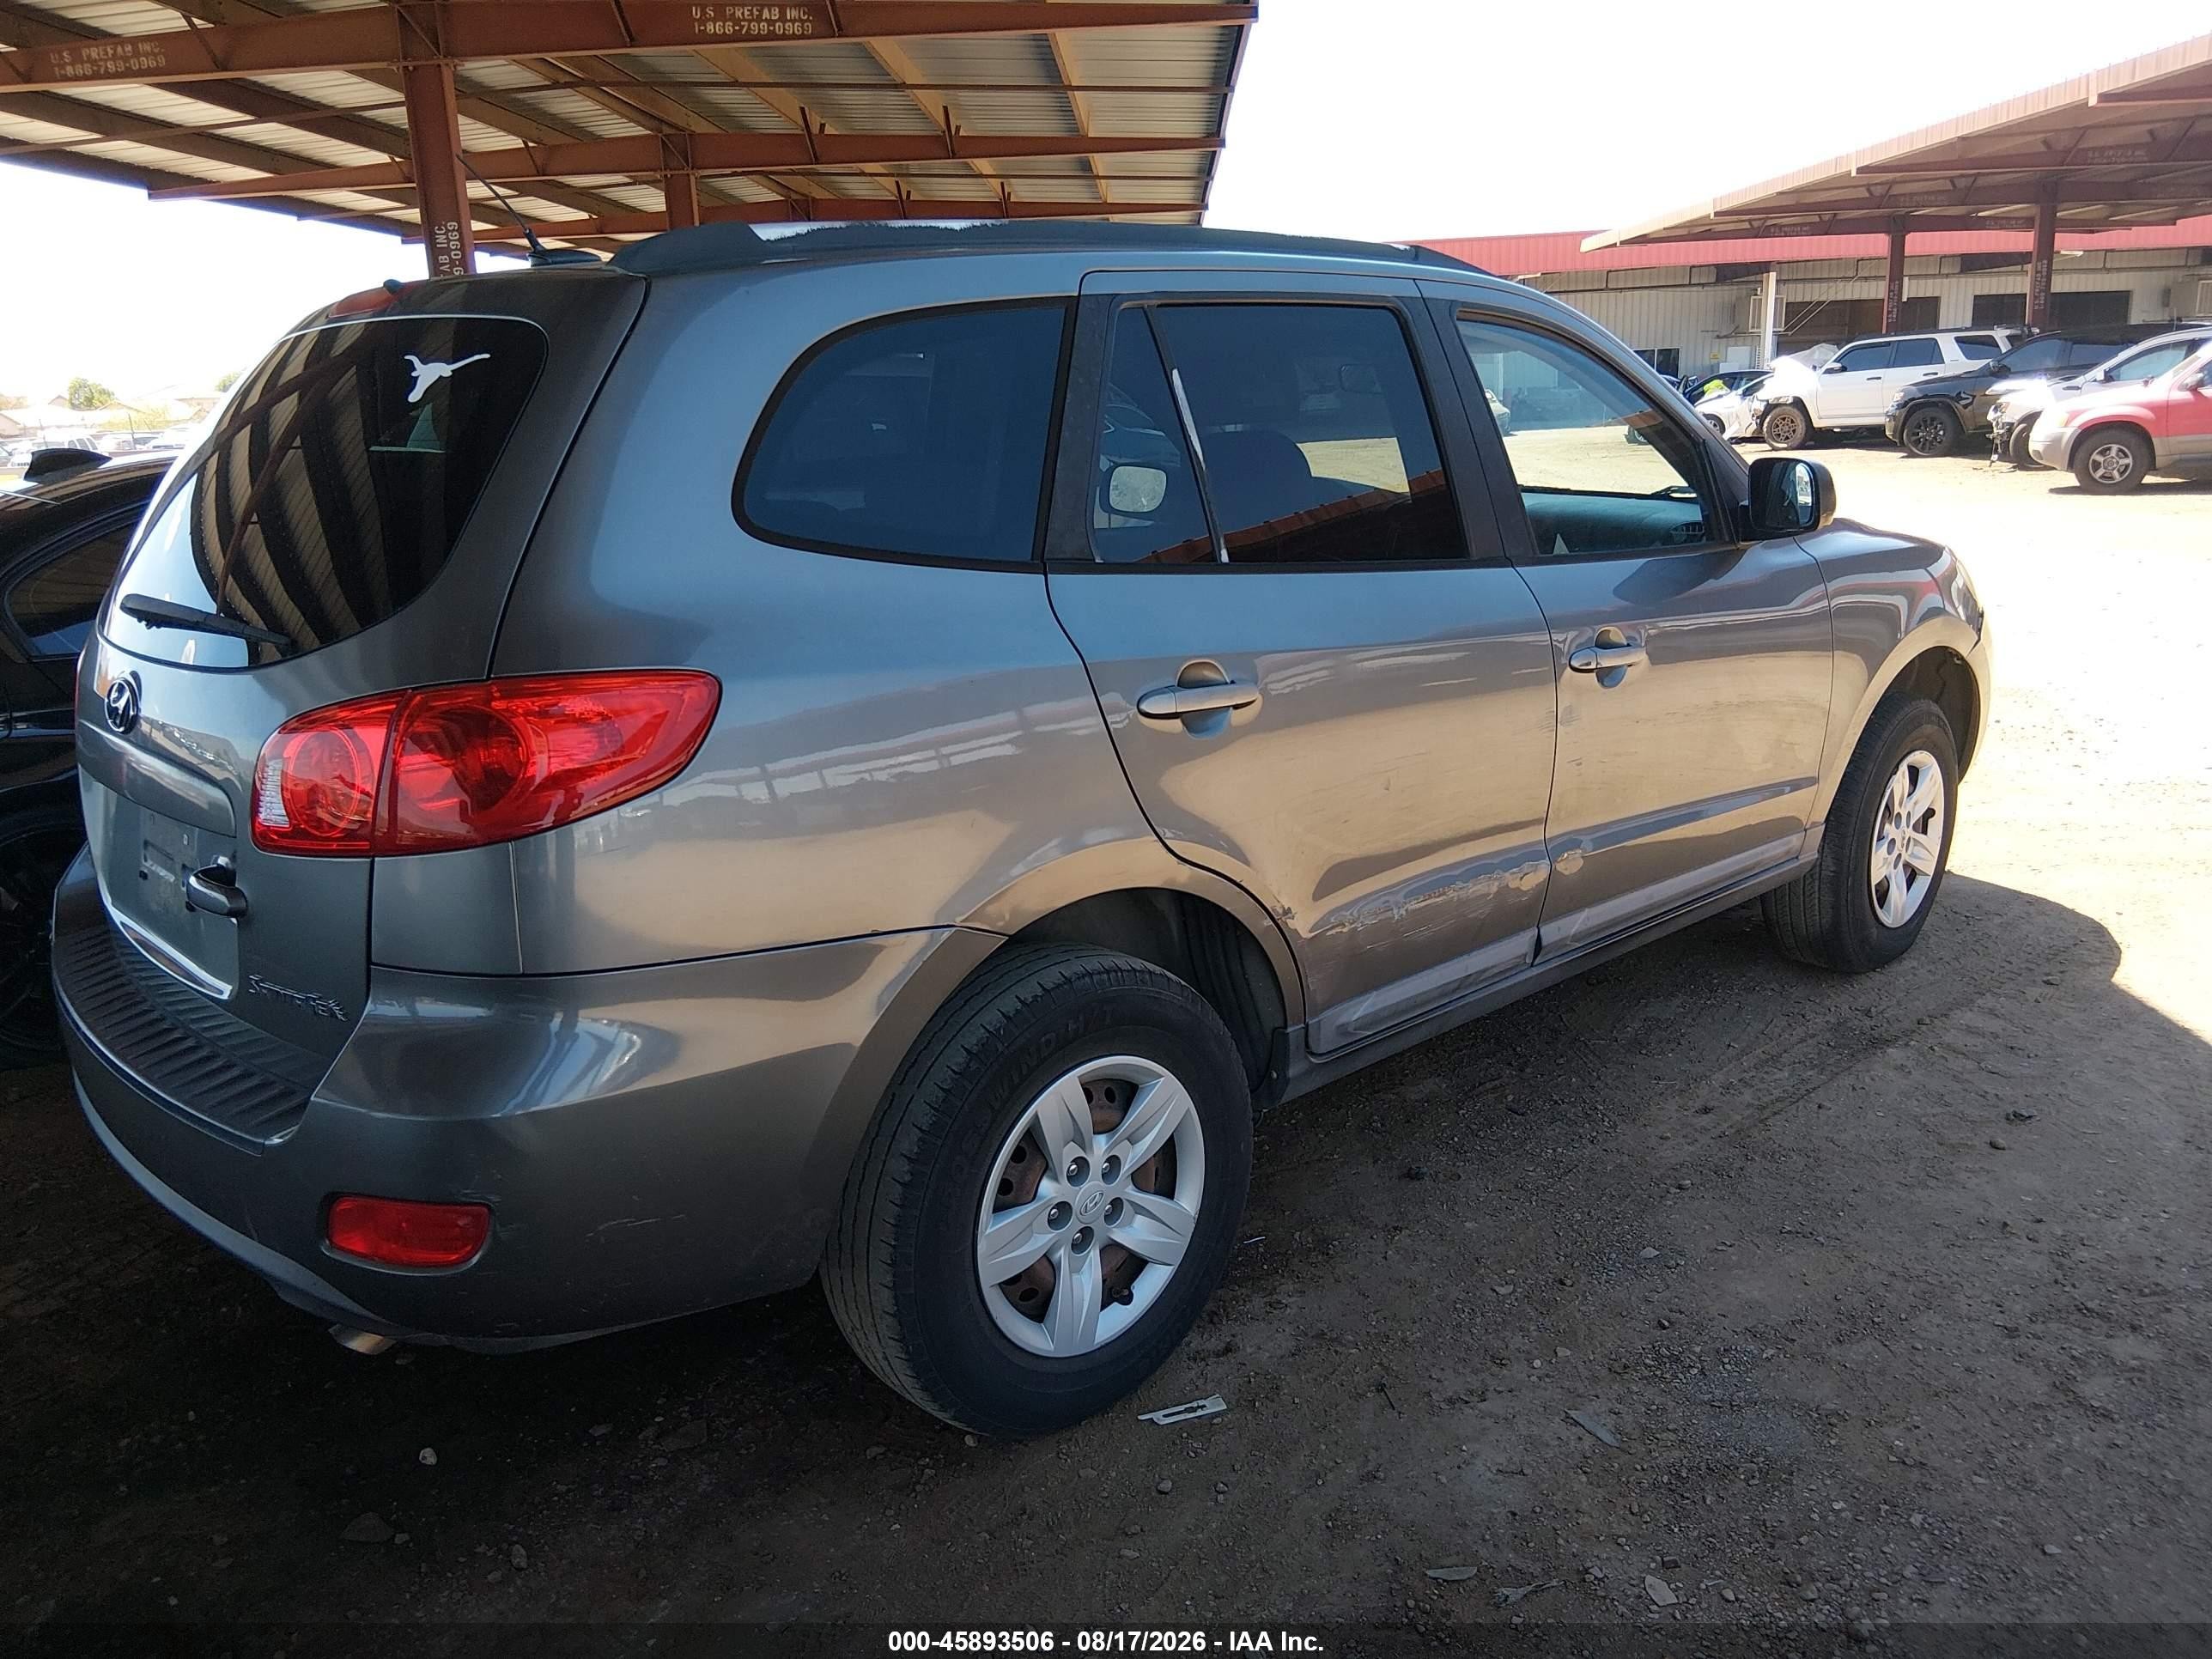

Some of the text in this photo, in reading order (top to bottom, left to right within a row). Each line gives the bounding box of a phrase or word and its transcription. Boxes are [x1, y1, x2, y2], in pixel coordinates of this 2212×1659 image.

[726, 6, 780, 20] PREFAB
[787, 6, 813, 20] INC.
[694, 21, 812, 35] 1-866-799-0969
[82, 43, 133, 61] PREFAB
[138, 41, 166, 53] INC.
[54, 54, 167, 80] 1-866-799-0969
[434, 222, 451, 277] AB INC.
